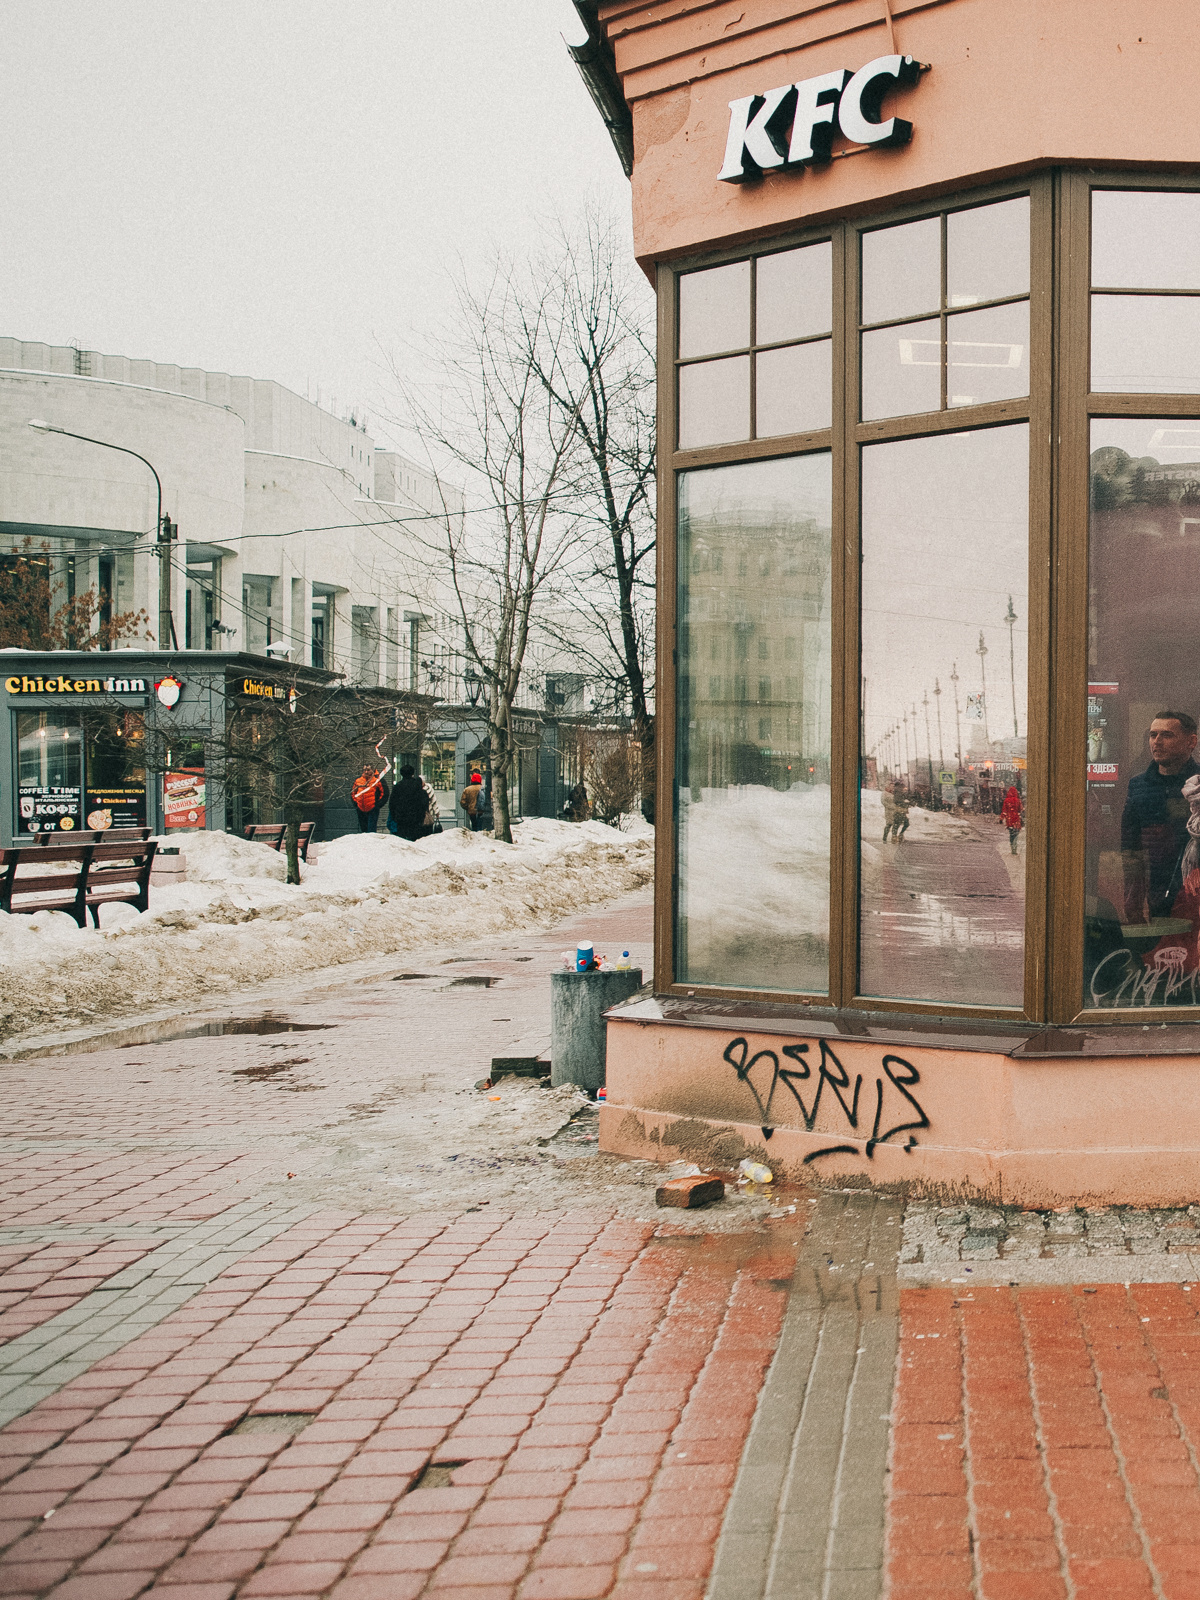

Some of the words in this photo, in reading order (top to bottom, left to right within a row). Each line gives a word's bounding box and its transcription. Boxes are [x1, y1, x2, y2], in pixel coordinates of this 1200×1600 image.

[716, 54, 903, 182] KFC
[4, 676, 101, 694] Chicken
[1092, 763, 1117, 774] ЗДЕСЬ
[19, 786, 49, 794] COFFEE
[36, 804, 78, 814] КОФЕ
[167, 799, 198, 811] НОВИНКА
